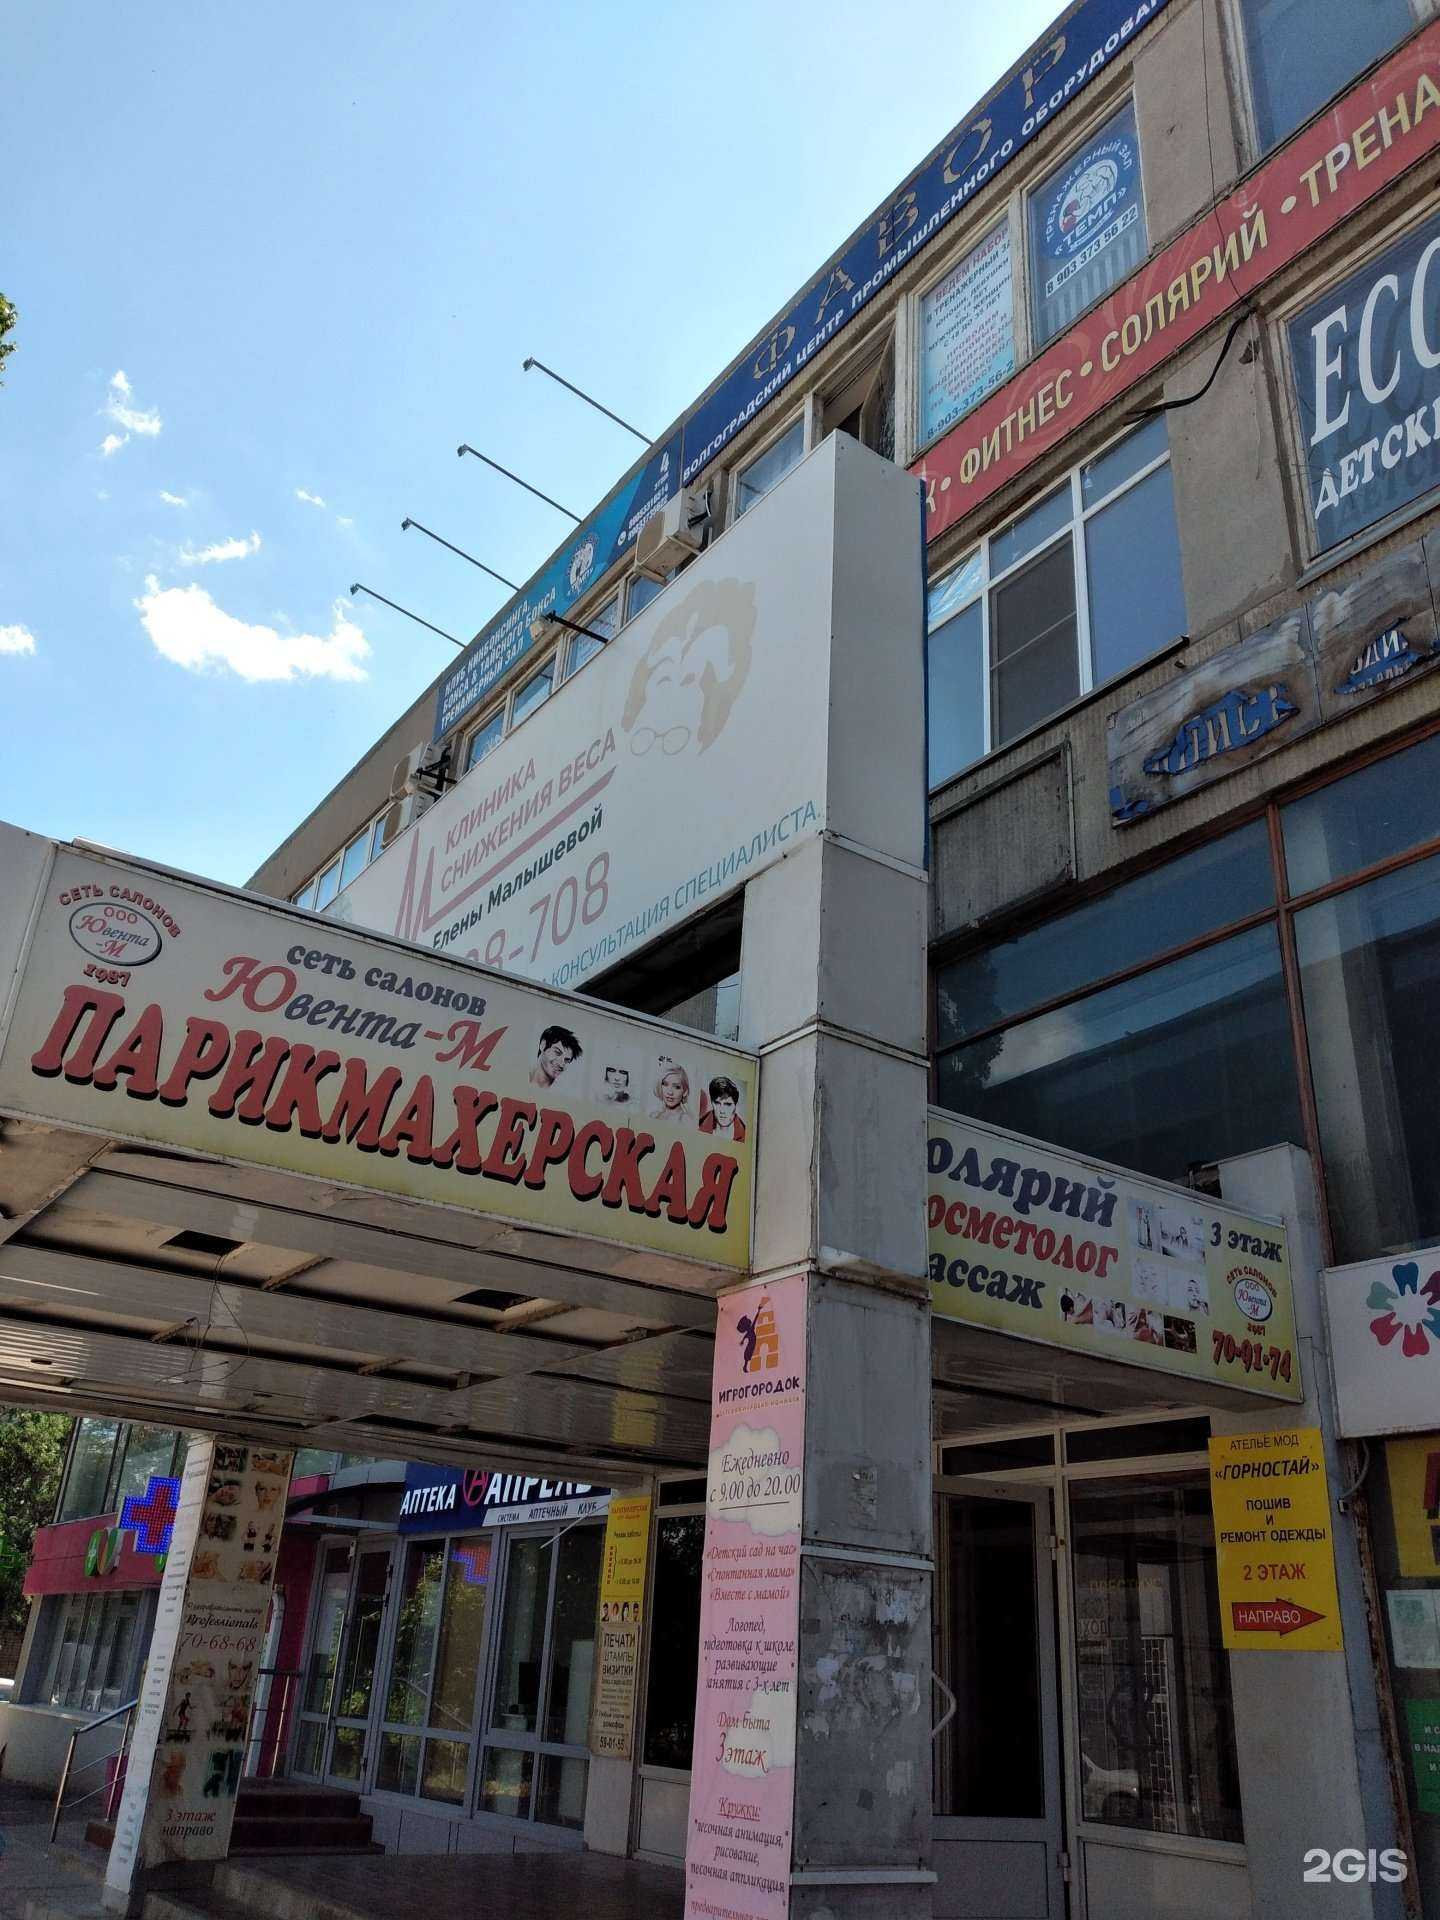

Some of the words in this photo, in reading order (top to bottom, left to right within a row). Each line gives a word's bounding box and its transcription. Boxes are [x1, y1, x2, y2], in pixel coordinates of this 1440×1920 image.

[1046, 138, 1121, 243] ТРЕНАЖЕРНЫЙ
[1118, 145, 1133, 171] ЗАЛ
[1055, 186, 1127, 256] «ТЕМП»
[1047, 280, 1054, 294] 8
[1056, 263, 1077, 286] 903
[1080, 242, 1101, 266] 373
[1104, 225, 1119, 244] 56
[1121, 206, 1138, 229] 22
[960, 369, 1075, 486] ФИТНЕС
[1101, 202, 1269, 373] СОЛЯРИЙ
[1299, 73, 1440, 209] ТРЕНА
[683, 360, 792, 483] ВОЛГОГРАДСКИЙ
[796, 309, 846, 370] ЦЕНТР
[851, 140, 1014, 310] ПРОМЫШЛЕННОГО
[440, 780, 553, 893] СНИЖЕНИЯ
[557, 727, 616, 799] ВЕСА
[444, 757, 537, 855] КЛИНИКА
[432, 895, 483, 950] Елены
[487, 802, 604, 916] Малышевой
[551, 896, 671, 990] КОНСУЛЬТАЦИЯ
[673, 800, 822, 911] СПЕЦИАЛИСТА.
[59, 884, 104, 906] СЕТЬ
[109, 884, 181, 938] САЛОНОВ
[104, 906, 138, 924] ООО
[75, 915, 150, 947] Ювента
[286, 945, 355, 982] сеть
[364, 967, 488, 1018] салонов
[203, 956, 509, 1073] Ювента-М
[31, 984, 740, 1234] ПАРИКМАХЕРСКАЯ
[1209, 1221, 1222, 1246] 3
[1228, 1229, 1283, 1263] этаж
[718, 1376, 800, 1404] ИГРОГОРОДОК
[1230, 1436, 1271, 1451] АТЕЛЬЕ
[1273, 1434, 1299, 1448] МОД
[721, 1448, 790, 1475] Ежедневно
[1215, 1456, 1320, 1480] «ГОРНОСТАЙ»
[719, 1479, 745, 1501] 9.00
[746, 1479, 761, 1498] до
[764, 1472, 800, 1496] 20.00
[400, 1484, 457, 1516] АПТЕКА
[497, 1512, 520, 1523] СИСТЕМА
[528, 1502, 568, 1520] АПТЕЧНЫЙ
[1246, 1498, 1291, 1511] ПОШИВ
[1265, 1515, 1274, 1525] И
[1220, 1531, 1266, 1543] РЕМОНТ
[1271, 1529, 1326, 1543] ОДЕЖДЫ
[706, 1546, 747, 1562] «Детский
[749, 1542, 765, 1558] сад
[765, 1545, 776, 1556] на
[1243, 1565, 1253, 1581] 2
[1257, 1563, 1306, 1580] ЭТАЖ
[186, 1614, 259, 1630] Professionals
[725, 1615, 766, 1634] Логопед,
[1239, 1610, 1301, 1624] НАПРАВО
[181, 1632, 257, 1652] 70-68-68
[603, 1632, 636, 1649] ПЕЧАТИ
[715, 1659, 779, 1675] развивающие
[726, 1749, 769, 1773] этаж
[718, 1797, 761, 1819] Кружки:
[162, 1825, 214, 1840] направо
[735, 1828, 784, 1848] анимация,
[713, 1845, 760, 1867] рисование,
[690, 1863, 728, 1882] песочная
[729, 1871, 786, 1893] аппликация
